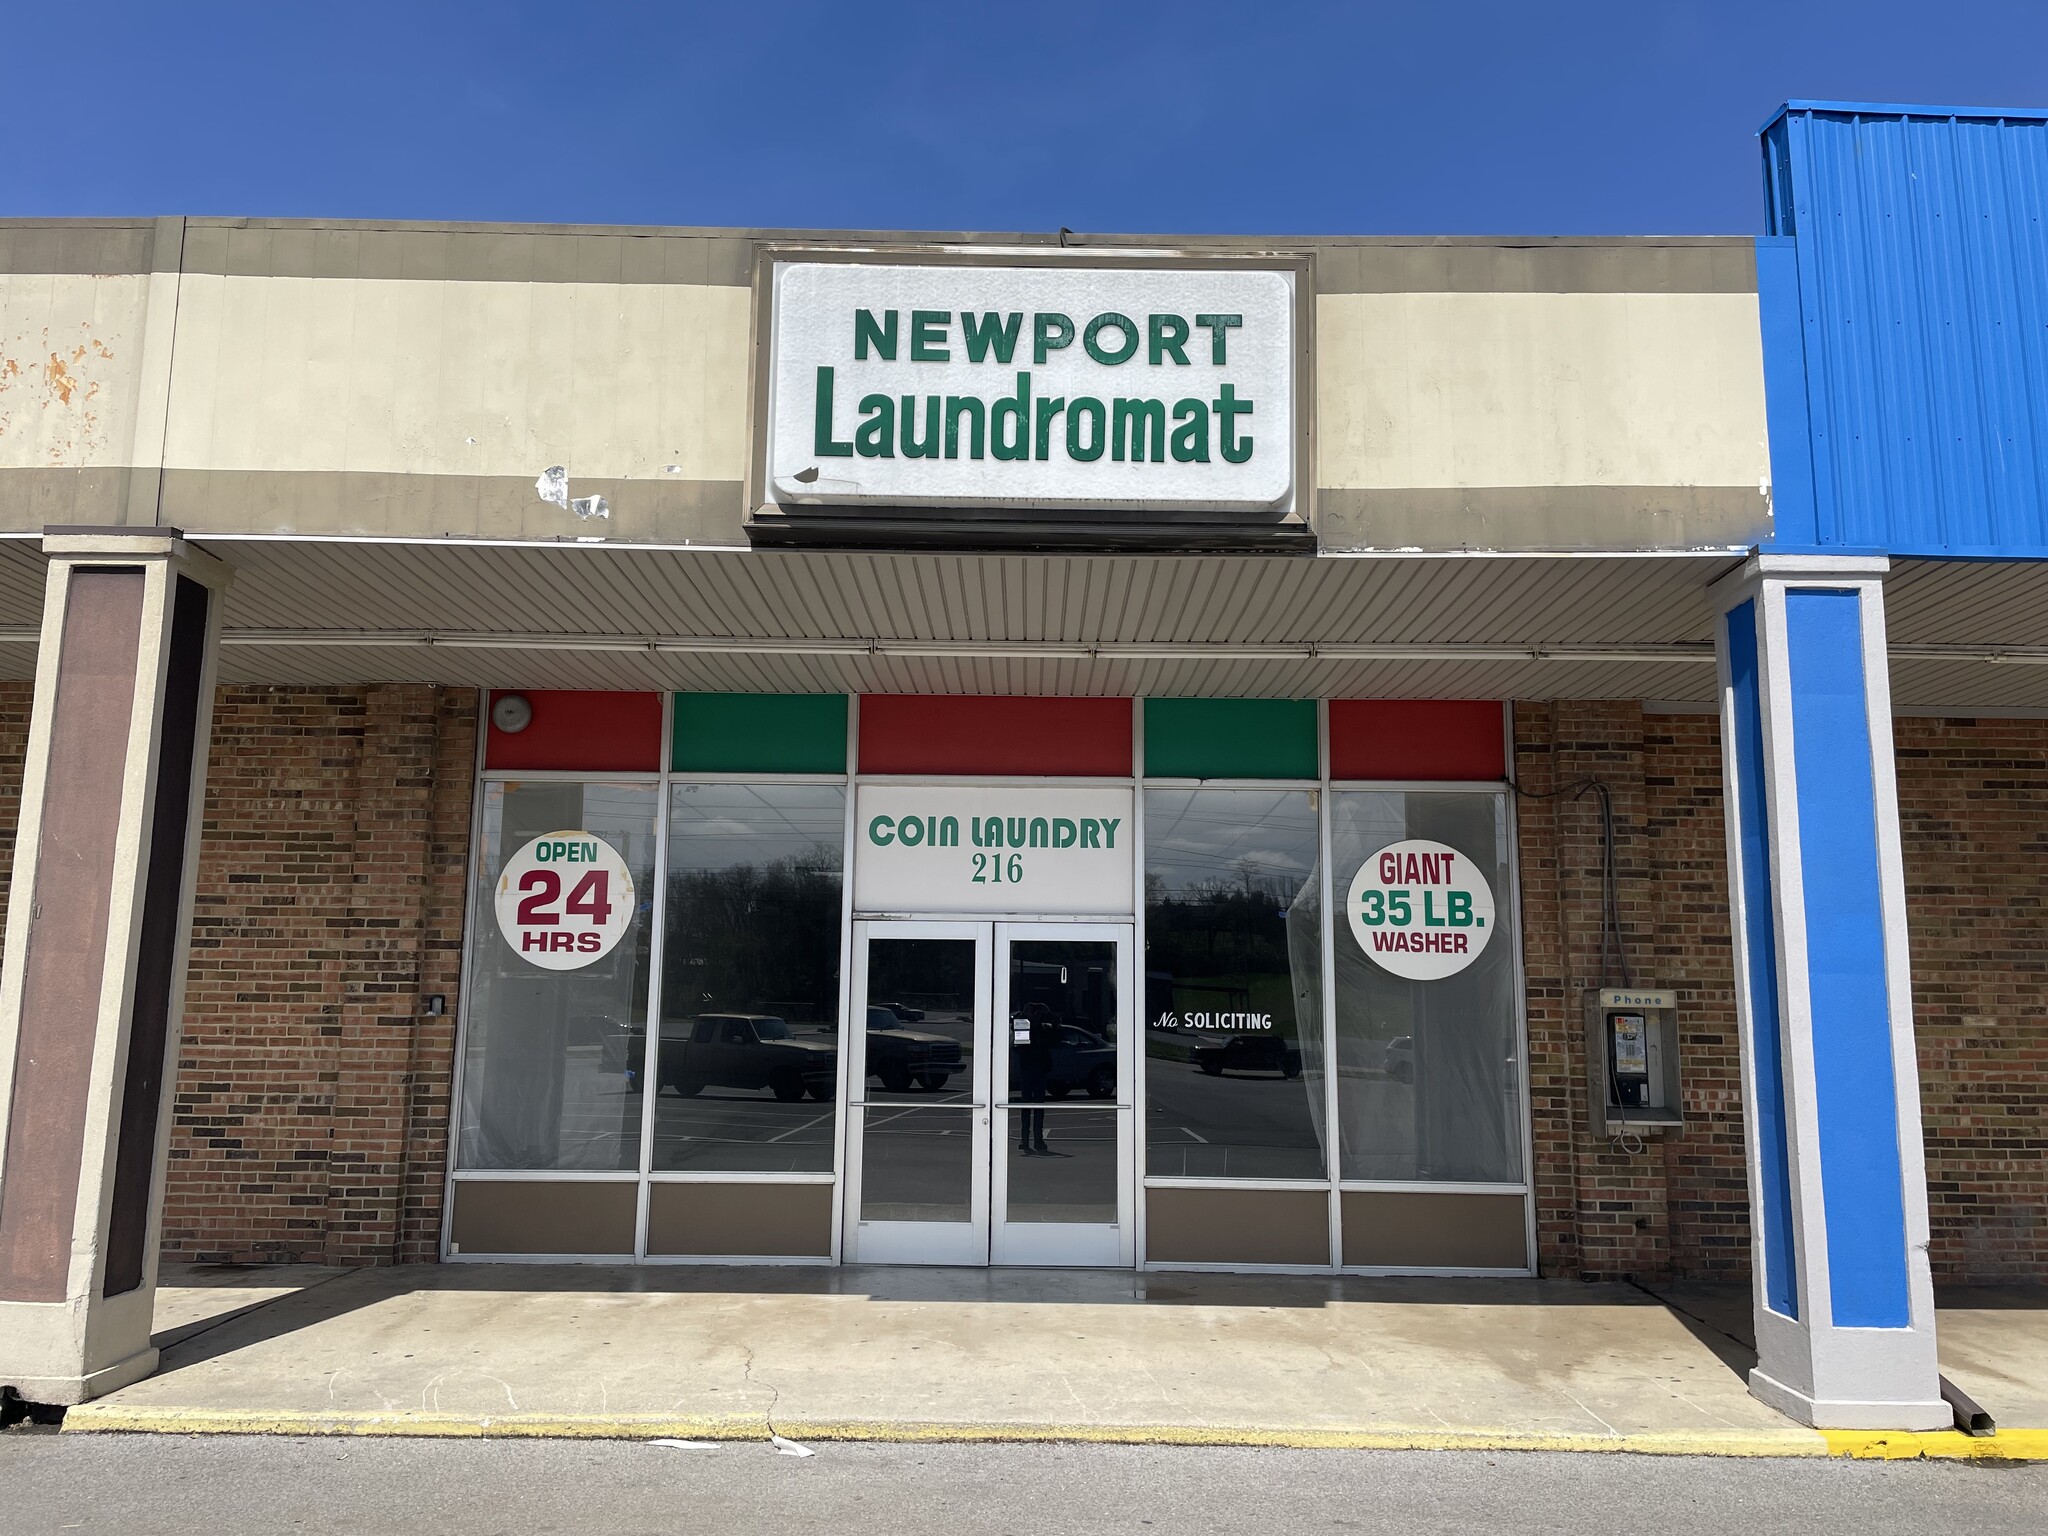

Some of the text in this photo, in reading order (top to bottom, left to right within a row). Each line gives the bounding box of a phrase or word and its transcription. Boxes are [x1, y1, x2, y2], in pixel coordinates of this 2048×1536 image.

[855, 308, 1243, 366] NEWPORT
[814, 366, 1254, 464] Laundromat
[869, 815, 1122, 849] COIN LAUNDRY
[536, 841, 598, 862] OPEN
[971, 853, 1023, 884] 216
[1379, 852, 1455, 885] GIANT
[517, 869, 612, 926] 24
[1361, 889, 1485, 928] 35 LB.
[522, 931, 602, 953] HRS
[1372, 931, 1468, 954] WASHER
[1613, 995, 1662, 1005] Phone
[1153, 1011, 1272, 1030] No SOLICITING
